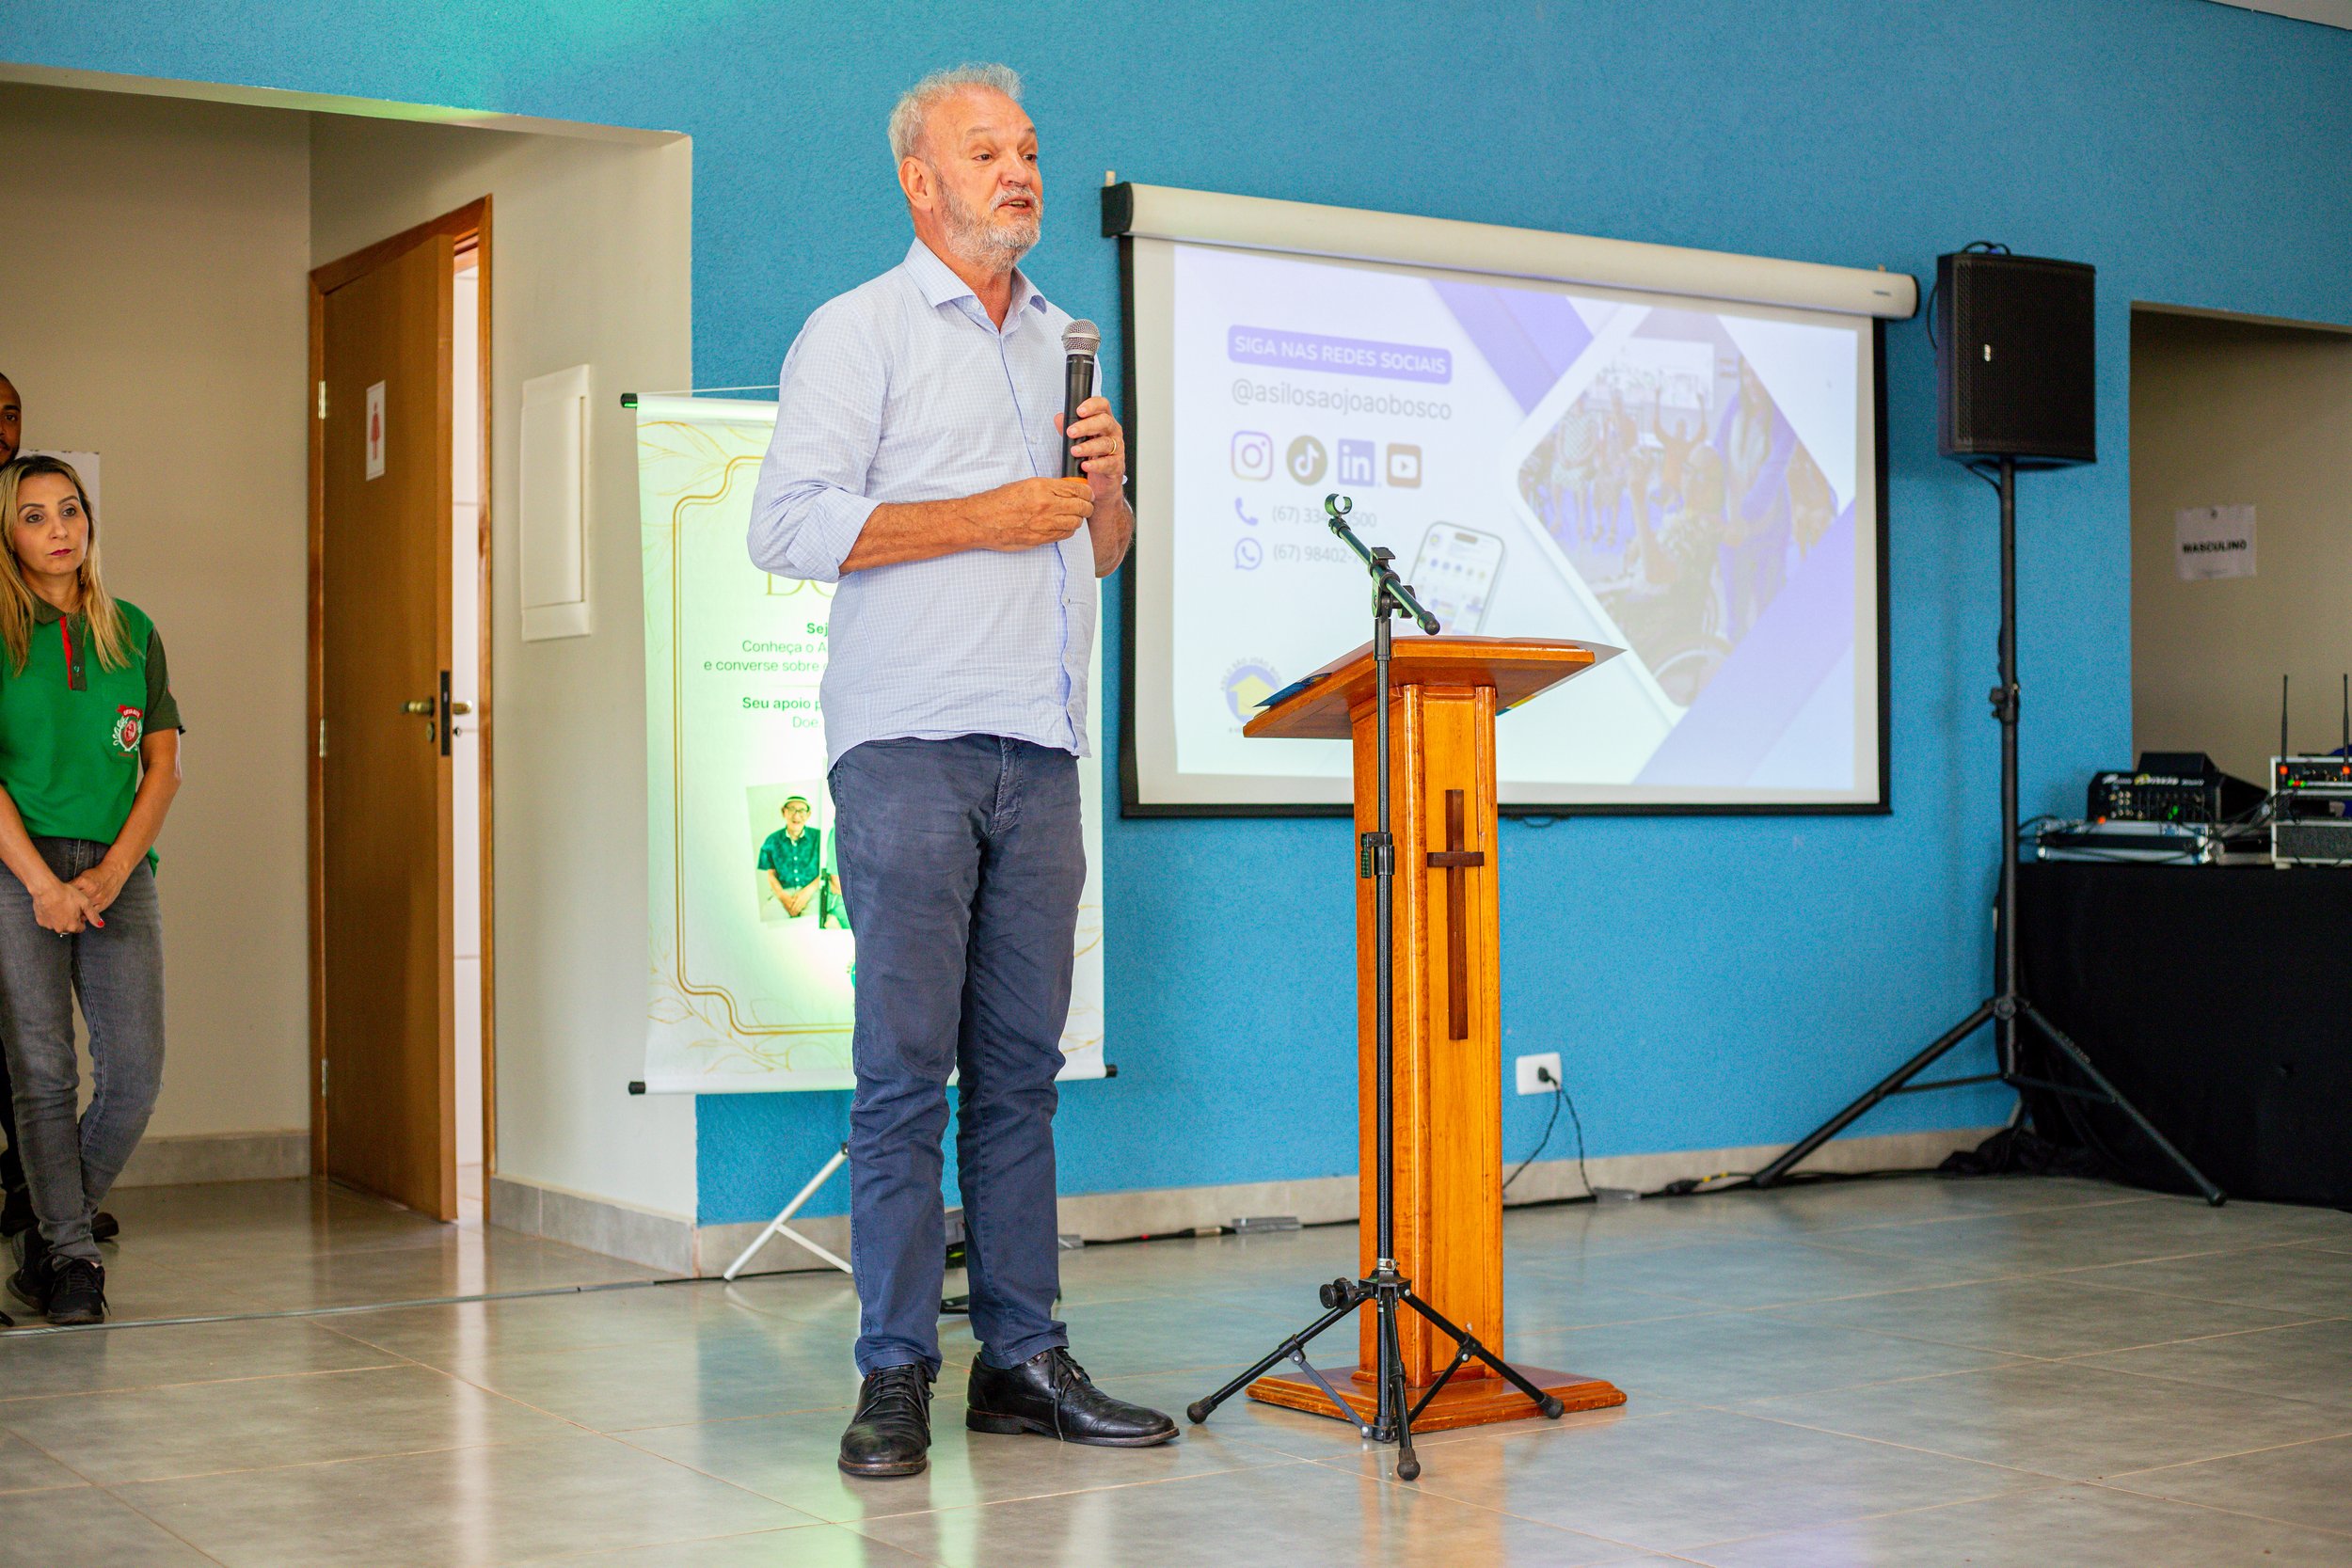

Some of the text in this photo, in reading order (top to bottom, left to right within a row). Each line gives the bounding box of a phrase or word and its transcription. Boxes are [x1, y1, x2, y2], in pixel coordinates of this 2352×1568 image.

[1234, 335, 1447, 374] SIGA NAS REDES SOCIAIS
[1232, 377, 1453, 420] @asilosaojoaobosco
[1272, 505, 1300, 524] (67)
[1273, 544, 1301, 562] (67)
[2183, 538, 2248, 553] MASCULINO
[741, 640, 803, 656] Conheça
[805, 642, 815, 654] o
[704, 660, 712, 672] e
[715, 660, 779, 672] converse
[782, 659, 819, 672] sobre
[742, 697, 770, 709] Seu
[773, 696, 811, 712] apoio
